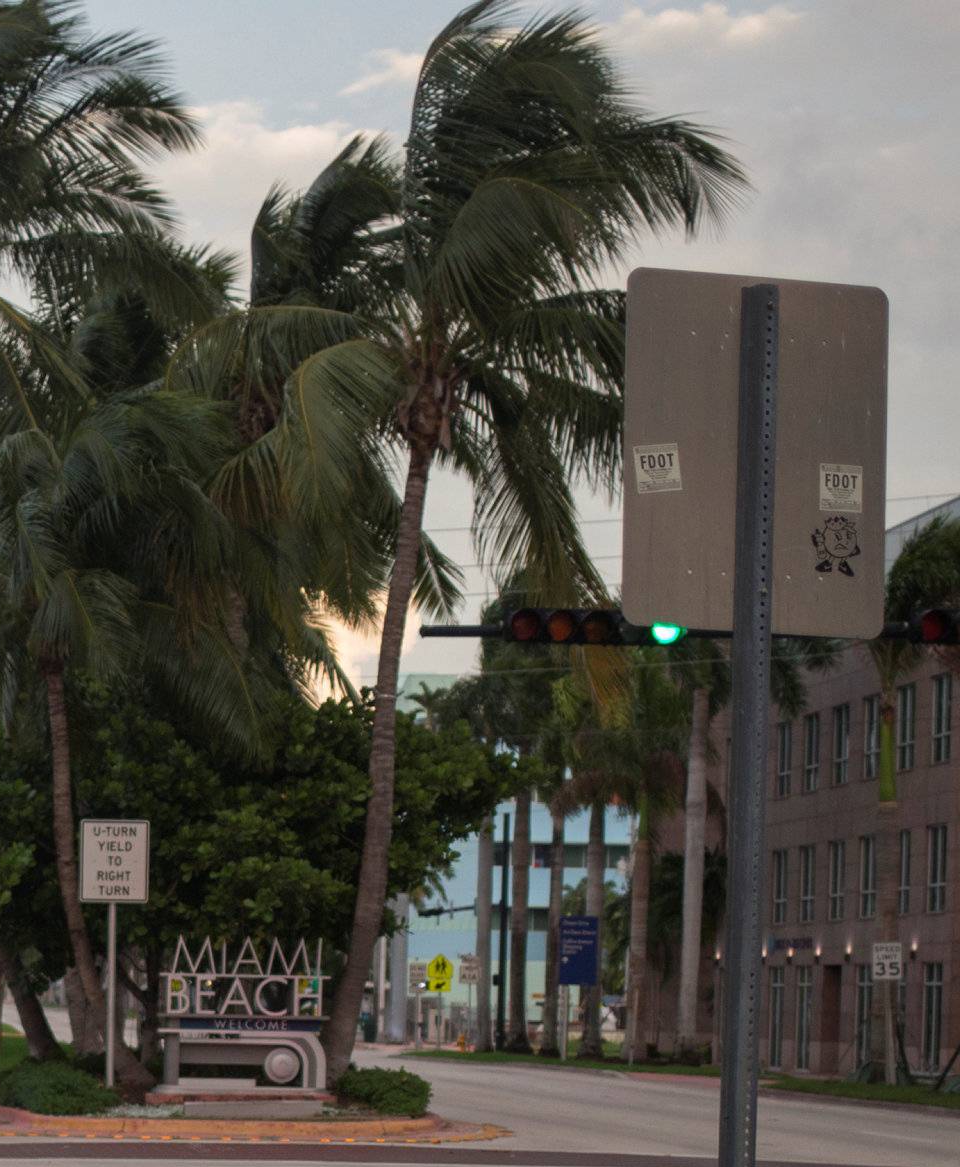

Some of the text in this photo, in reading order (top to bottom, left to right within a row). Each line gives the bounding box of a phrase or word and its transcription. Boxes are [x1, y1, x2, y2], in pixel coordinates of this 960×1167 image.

[640, 453, 674, 470] FDOT
[825, 473, 858, 489] FDOT
[93, 826, 137, 837] U-TURN
[98, 841, 132, 852] YIELD
[108, 855, 122, 866] TO
[97, 870, 131, 881] RIGHT
[99, 885, 130, 896] TURN
[171, 934, 323, 975] MIAMI
[875, 961, 900, 976] 35
[166, 975, 323, 1017] BEACH
[214, 1018, 288, 1031] WELCOME
